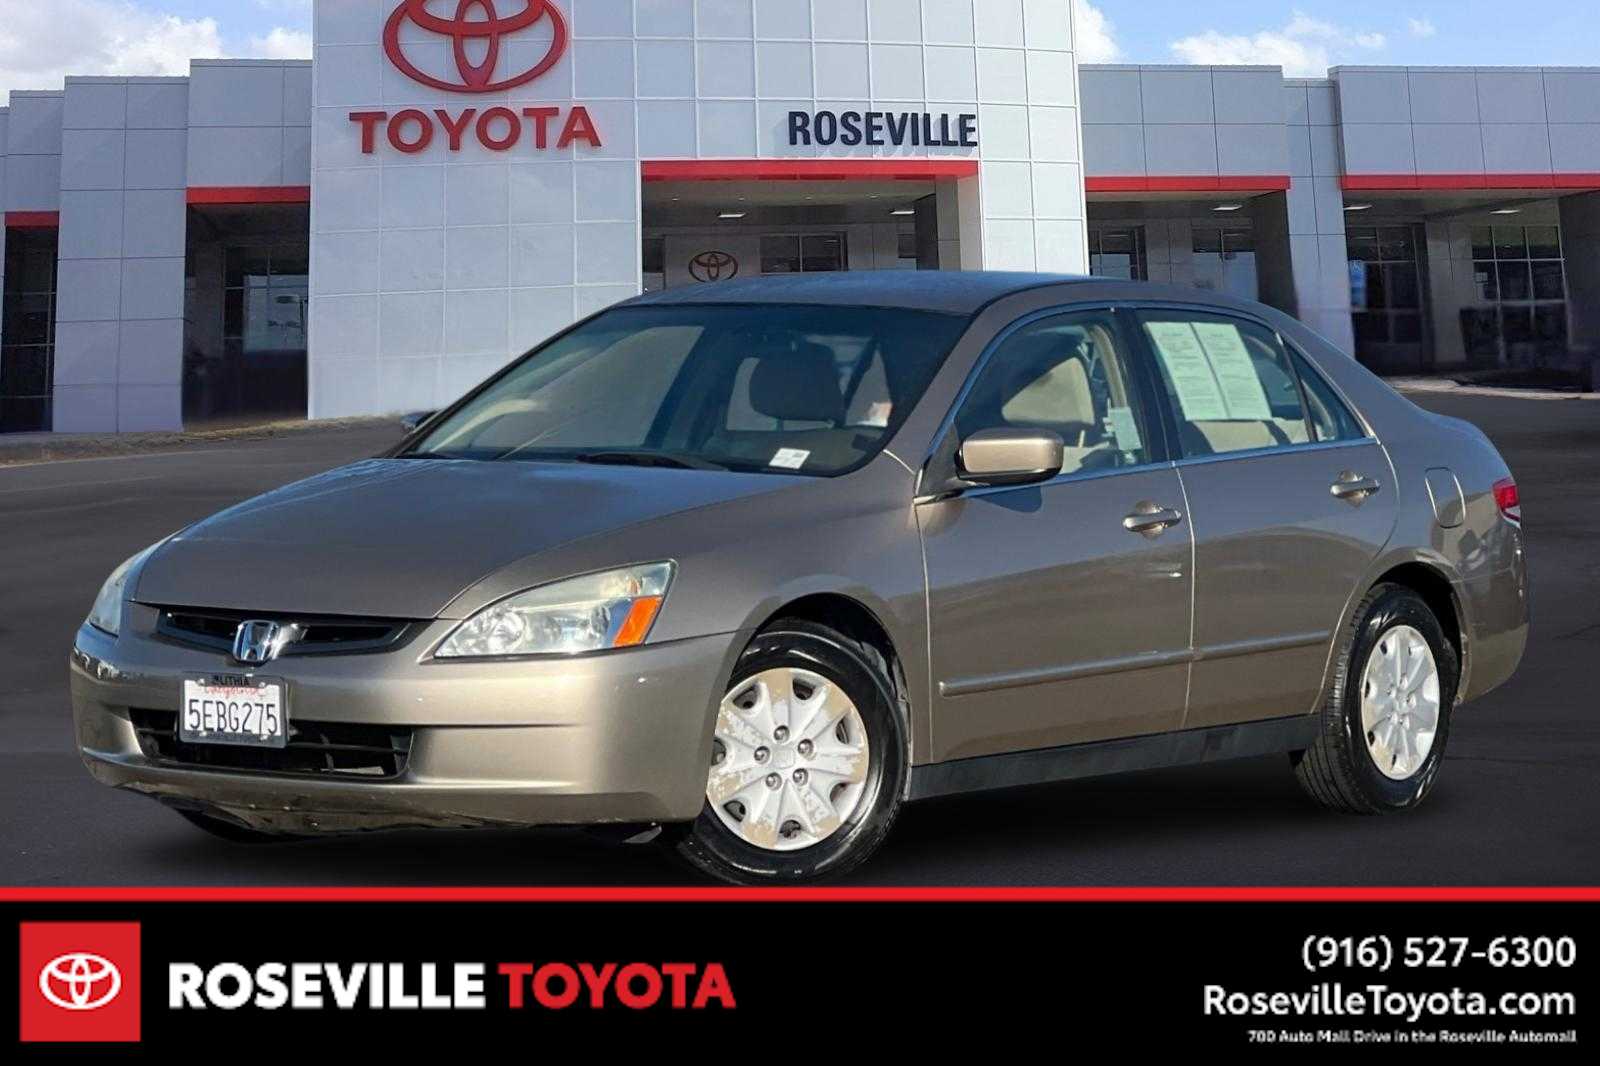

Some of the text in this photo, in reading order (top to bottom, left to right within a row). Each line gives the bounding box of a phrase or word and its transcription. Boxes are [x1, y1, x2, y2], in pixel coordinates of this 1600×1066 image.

[349, 106, 602, 154] TOYOTA
[788, 110, 978, 147] ROSEVILLE
[188, 698, 278, 735] 5EBG275
